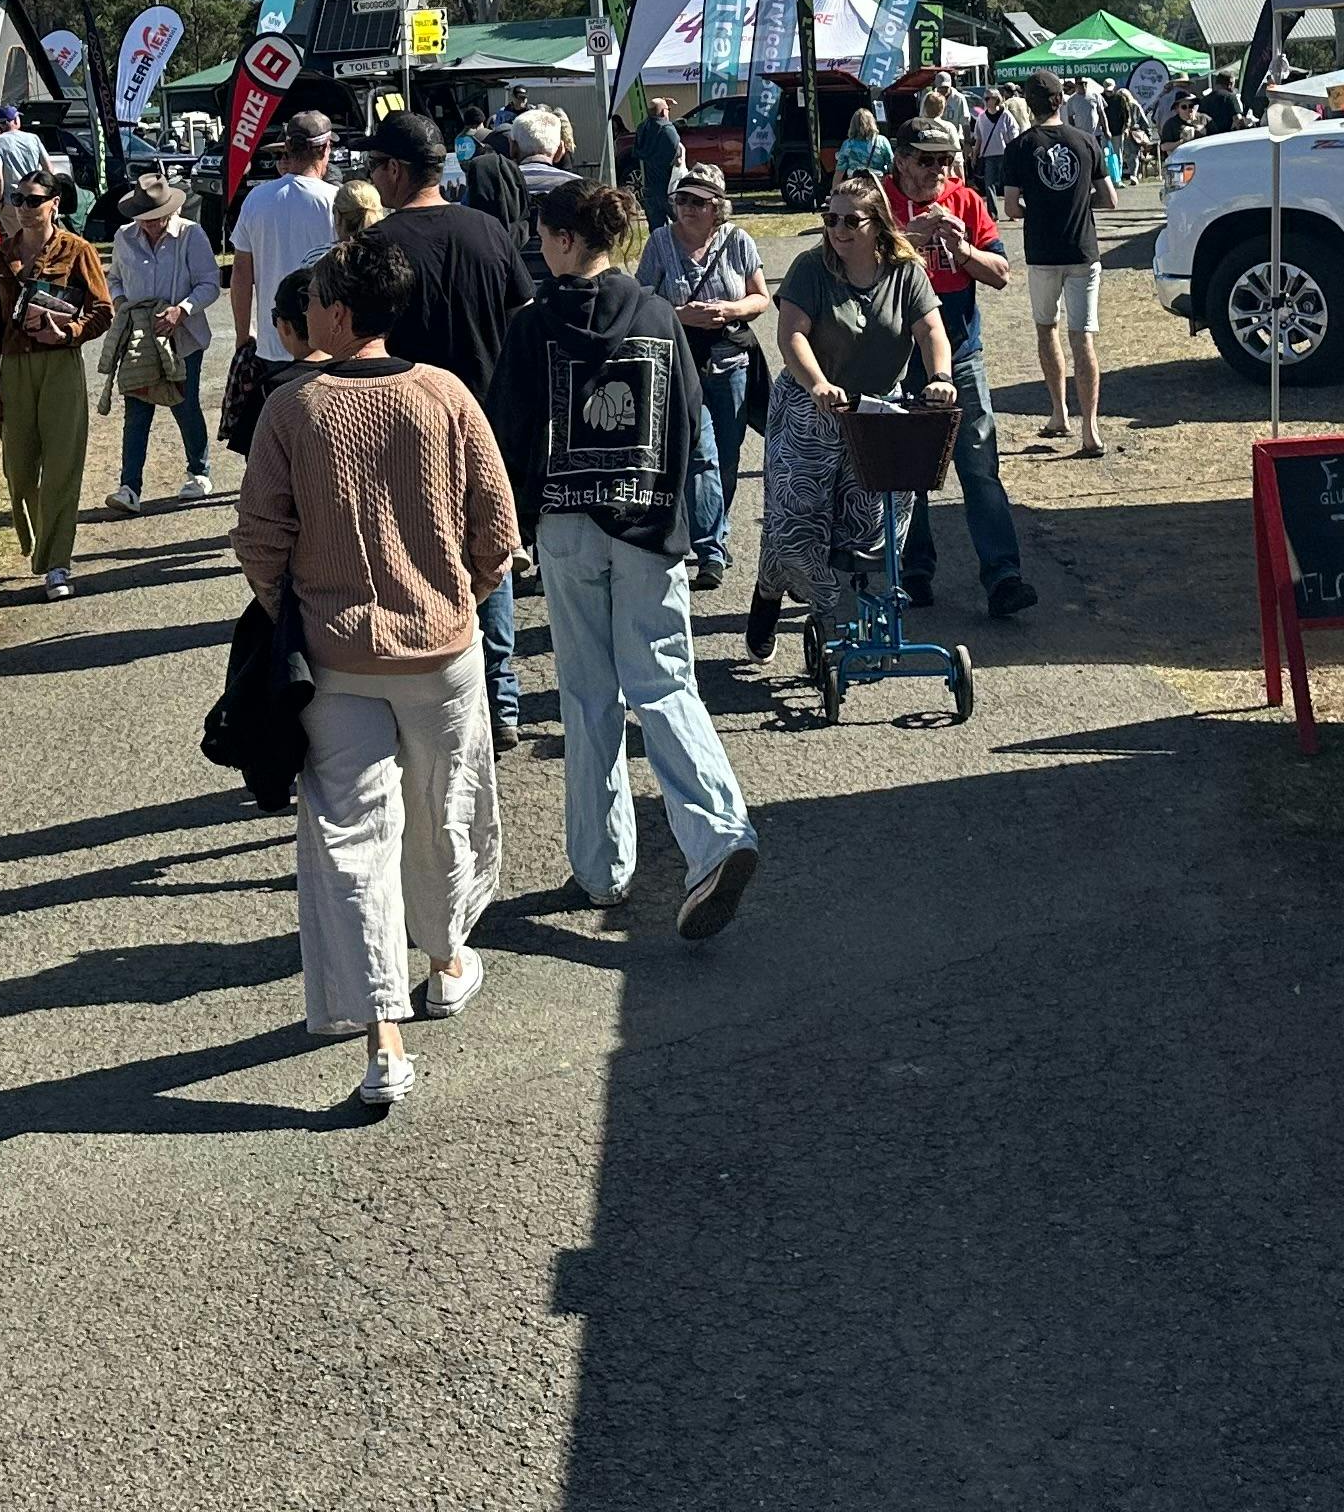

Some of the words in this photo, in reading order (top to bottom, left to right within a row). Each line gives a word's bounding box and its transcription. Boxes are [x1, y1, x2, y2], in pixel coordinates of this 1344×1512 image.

[592, 36, 605, 48] 10
[123, 54, 155, 102] CLEAR
[349, 60, 390, 72] TOILETS
[997, 67, 1017, 78] PORT
[1066, 64, 1073, 75] &
[1075, 63, 1109, 75] DISTRICT
[1110, 62, 1130, 73] 4WD
[232, 89, 269, 153] PRIZE
[540, 480, 607, 514] Stash
[612, 477, 674, 507] House
